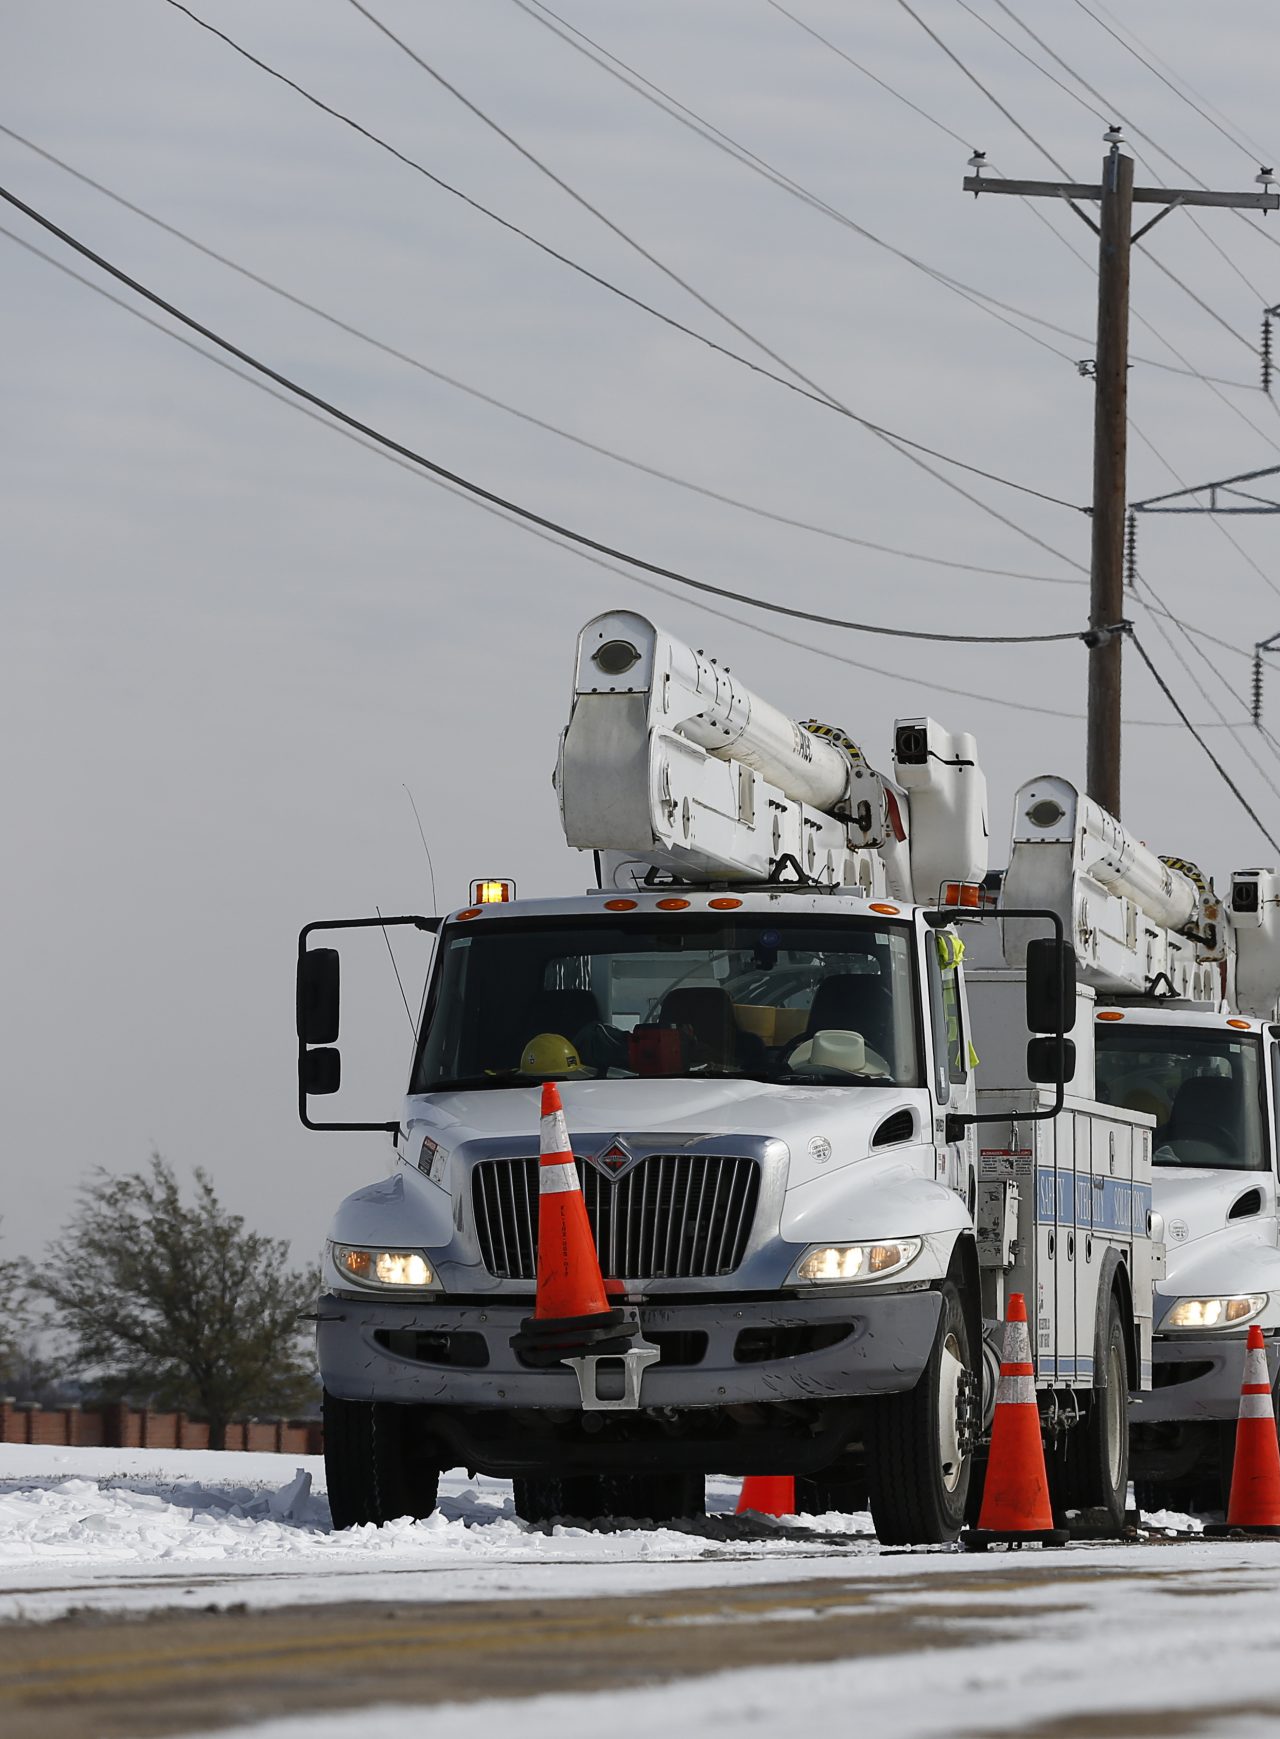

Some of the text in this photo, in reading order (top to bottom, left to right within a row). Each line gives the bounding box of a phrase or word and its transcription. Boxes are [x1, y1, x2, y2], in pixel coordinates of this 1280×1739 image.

[1040, 1176, 1144, 1228] SAFETY NTEGRITY SOLUTIONS
